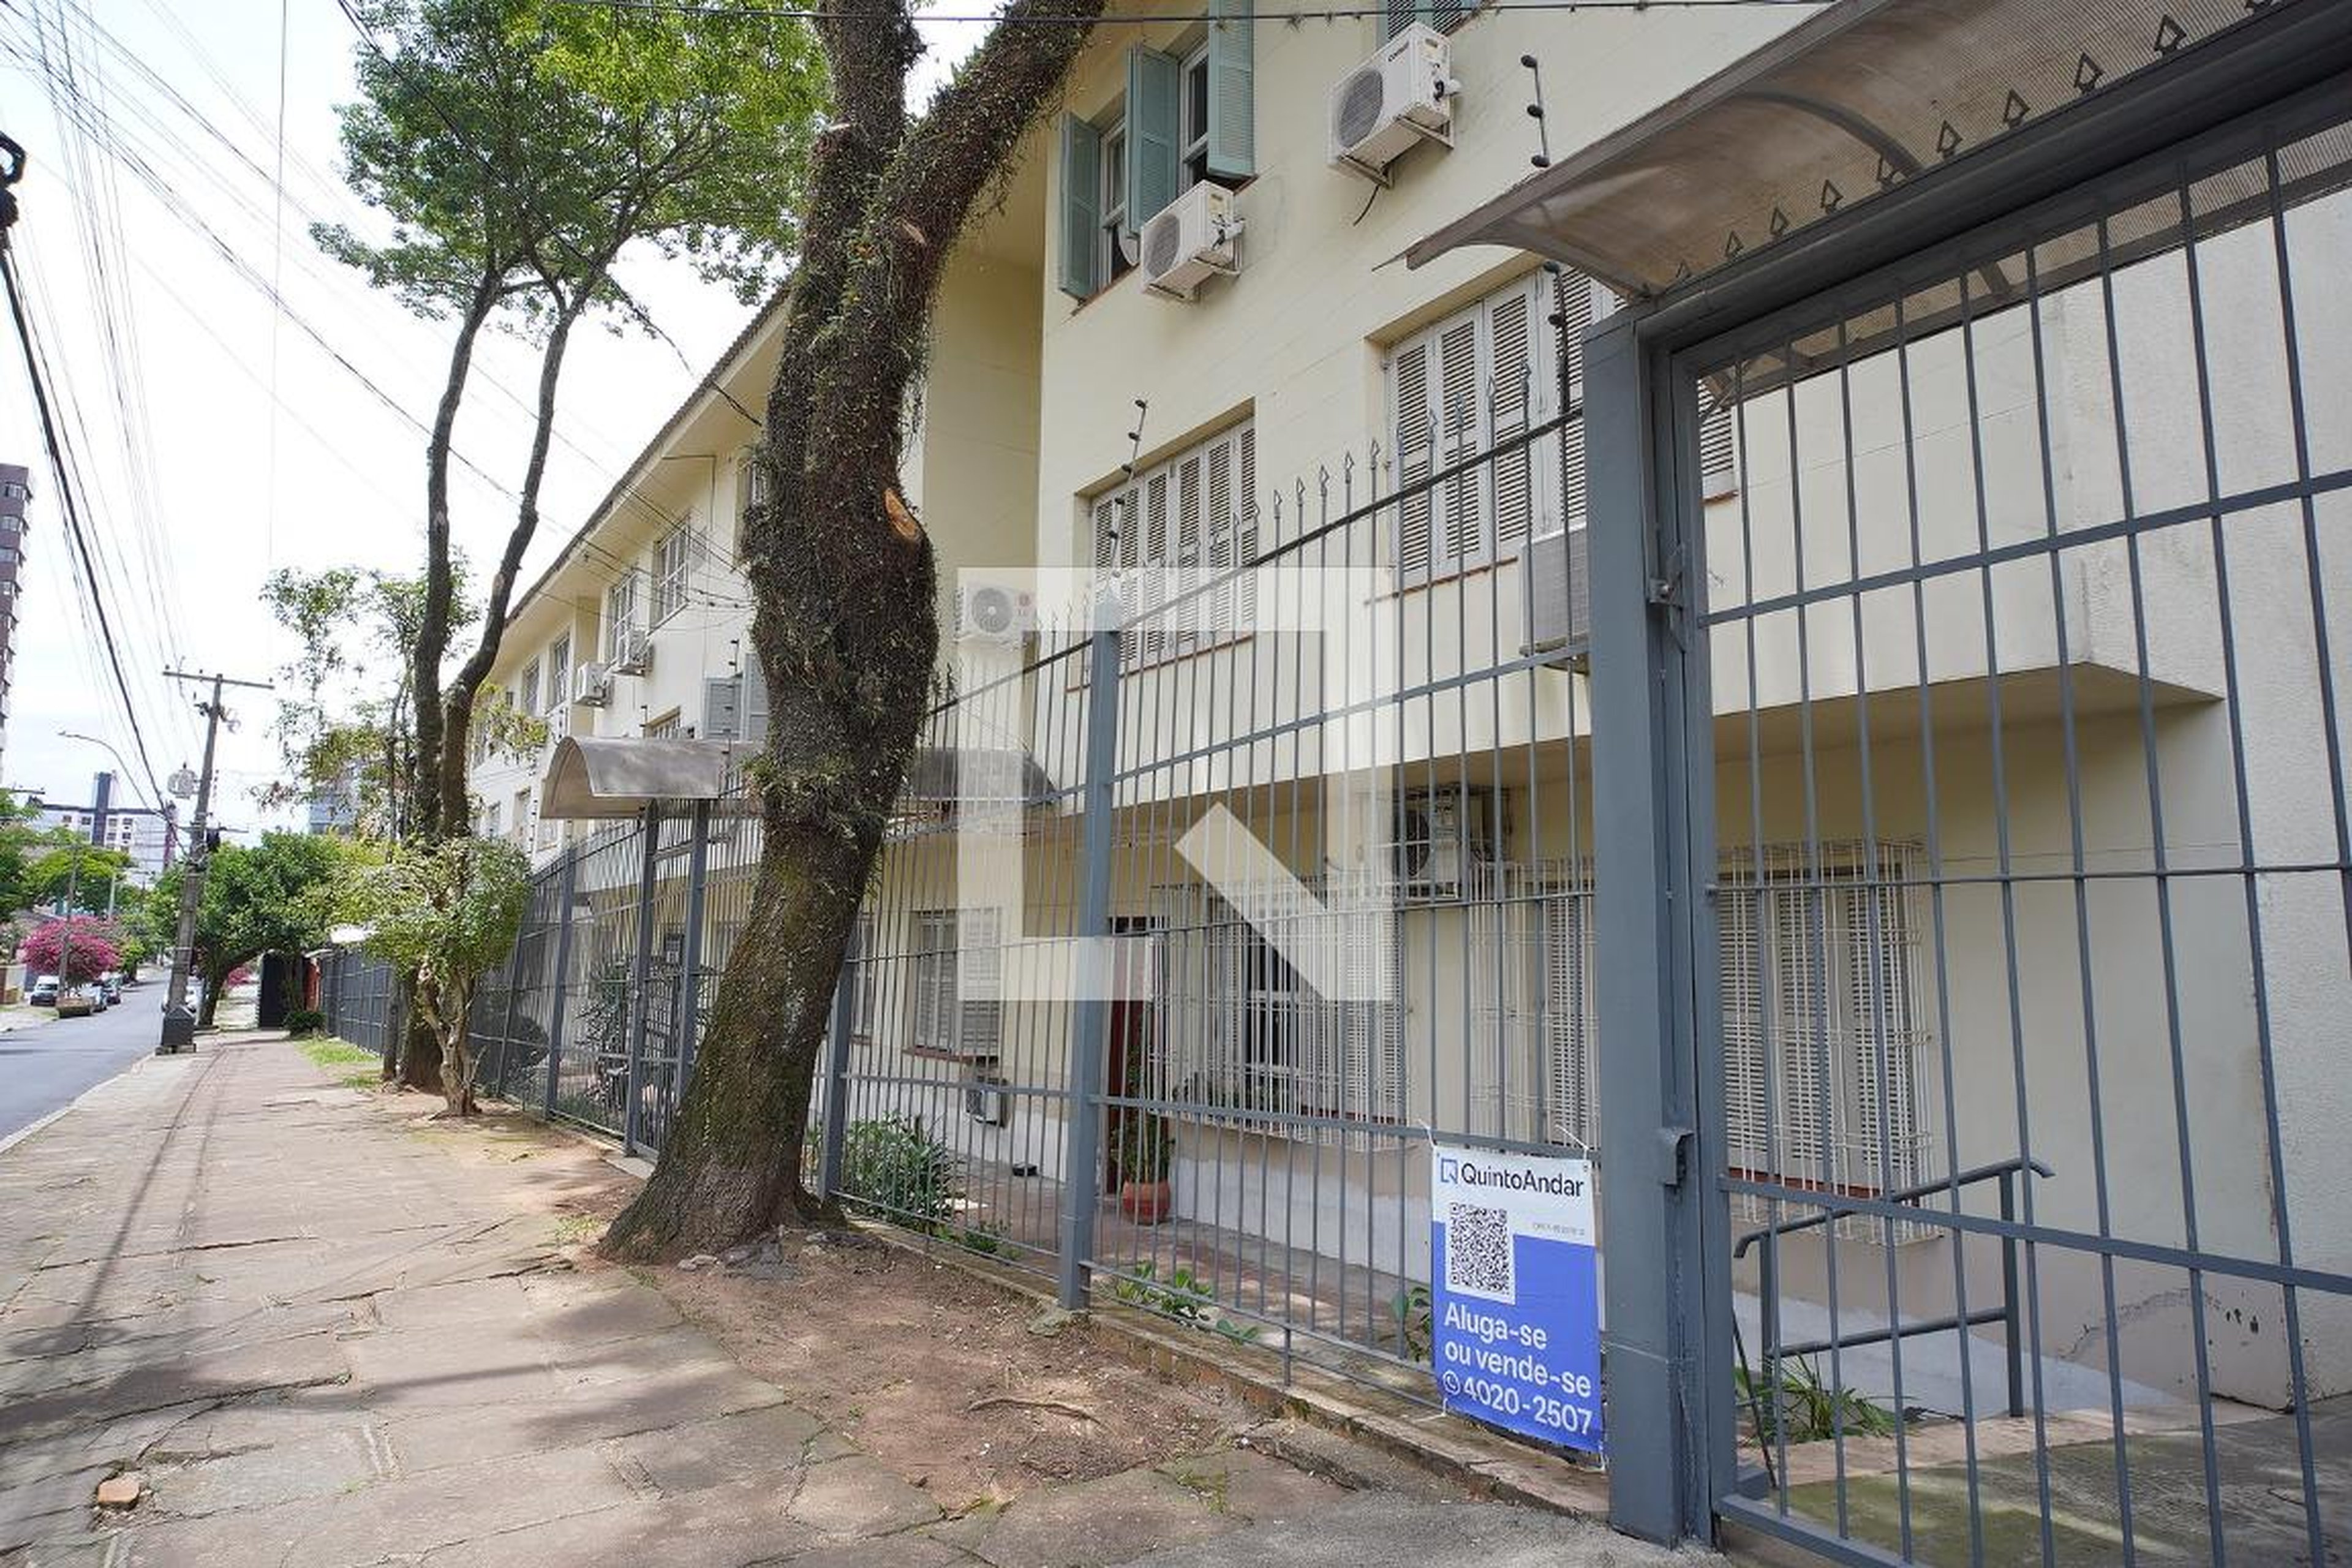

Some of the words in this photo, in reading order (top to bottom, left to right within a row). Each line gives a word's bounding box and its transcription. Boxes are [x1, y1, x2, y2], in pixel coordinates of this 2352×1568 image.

[1461, 1163, 1584, 1196] QuintoAndar
[1444, 1302, 1547, 1349] Aluga-se
[1445, 1341, 1471, 1366] ou
[1475, 1349, 1591, 1397] vende-se
[1463, 1378, 1593, 1434] 4020-2507
